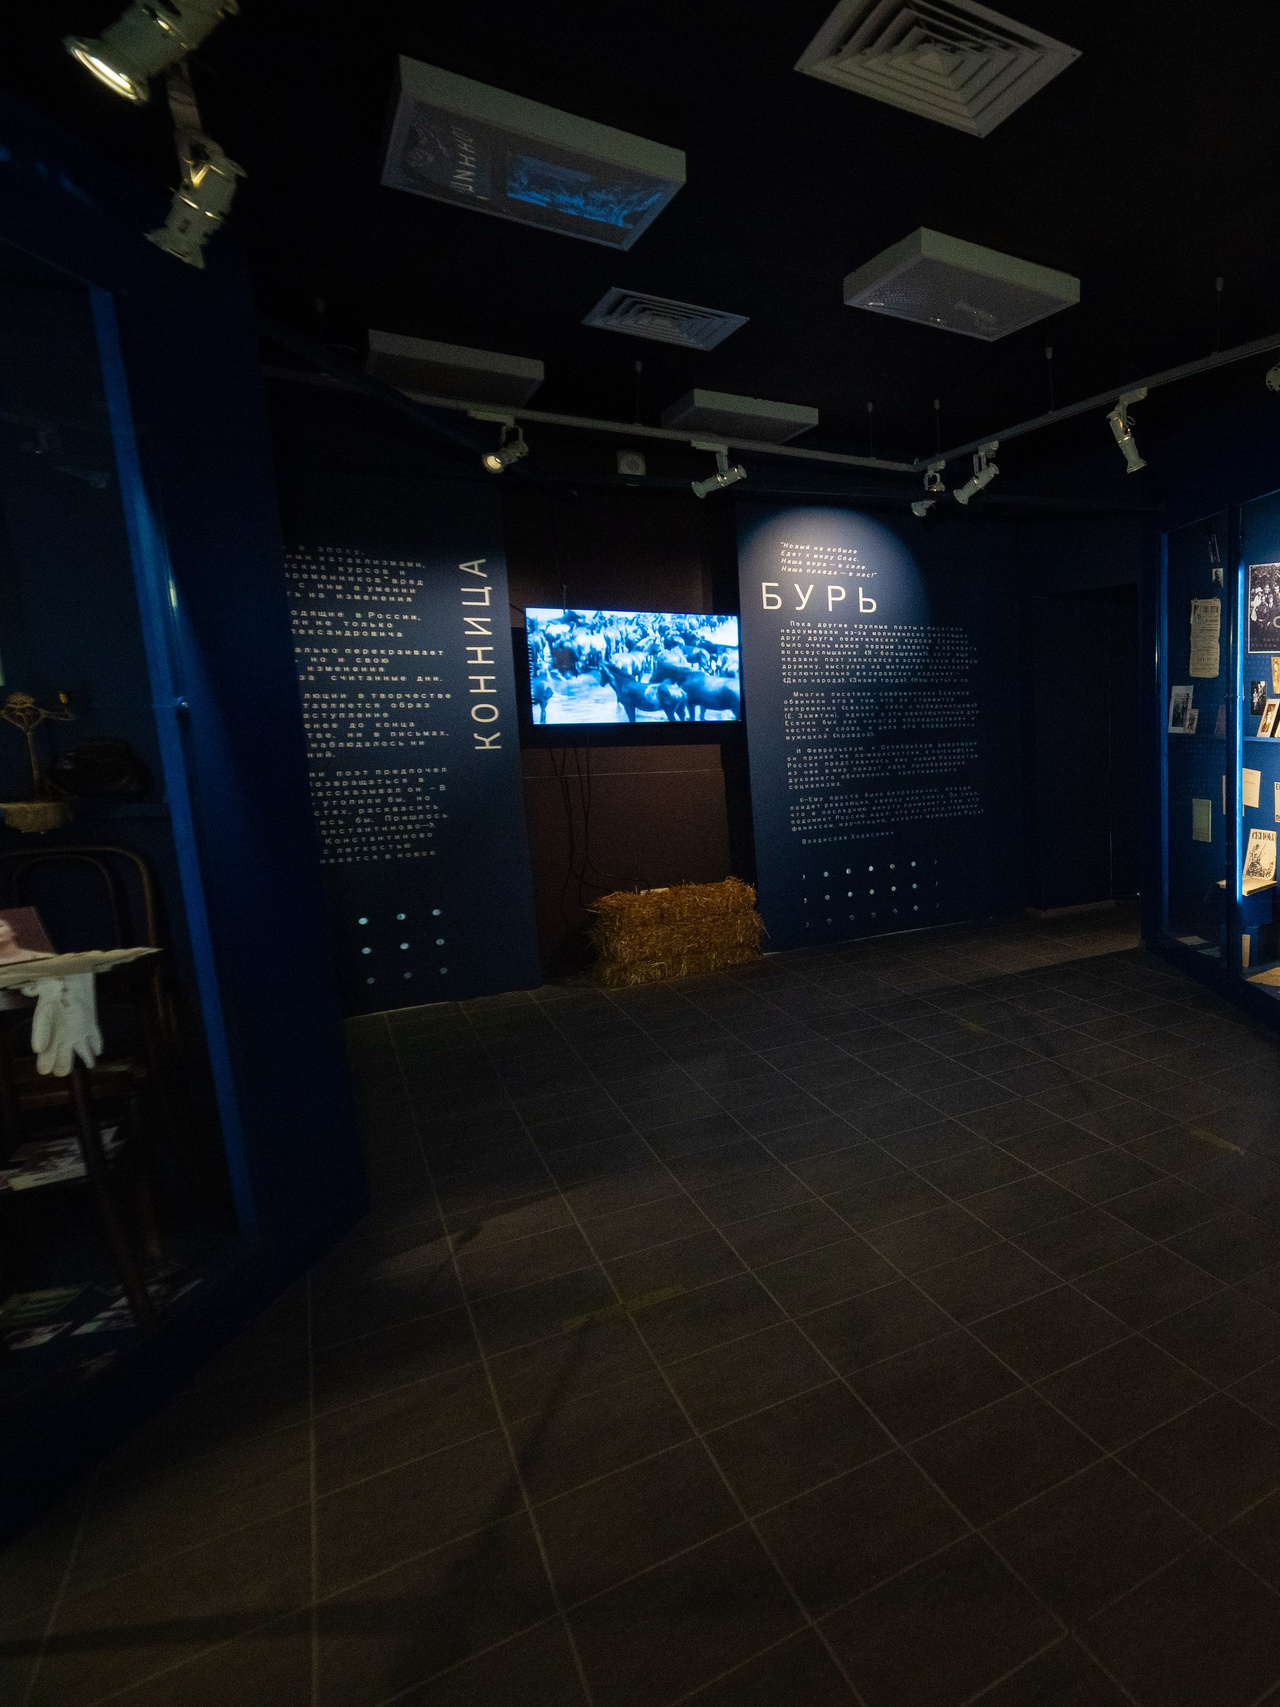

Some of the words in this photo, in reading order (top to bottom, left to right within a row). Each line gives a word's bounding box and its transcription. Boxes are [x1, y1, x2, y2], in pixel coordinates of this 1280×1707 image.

[761, 581, 878, 614] БУРЬ
[458, 558, 503, 750] КОННИЦА
[375, 767, 447, 775] предпочел
[323, 798, 381, 807] утопили
[358, 805, 439, 814] расквасить
[385, 813, 448, 821] Пришлось
[325, 832, 433, 844] Константиново
